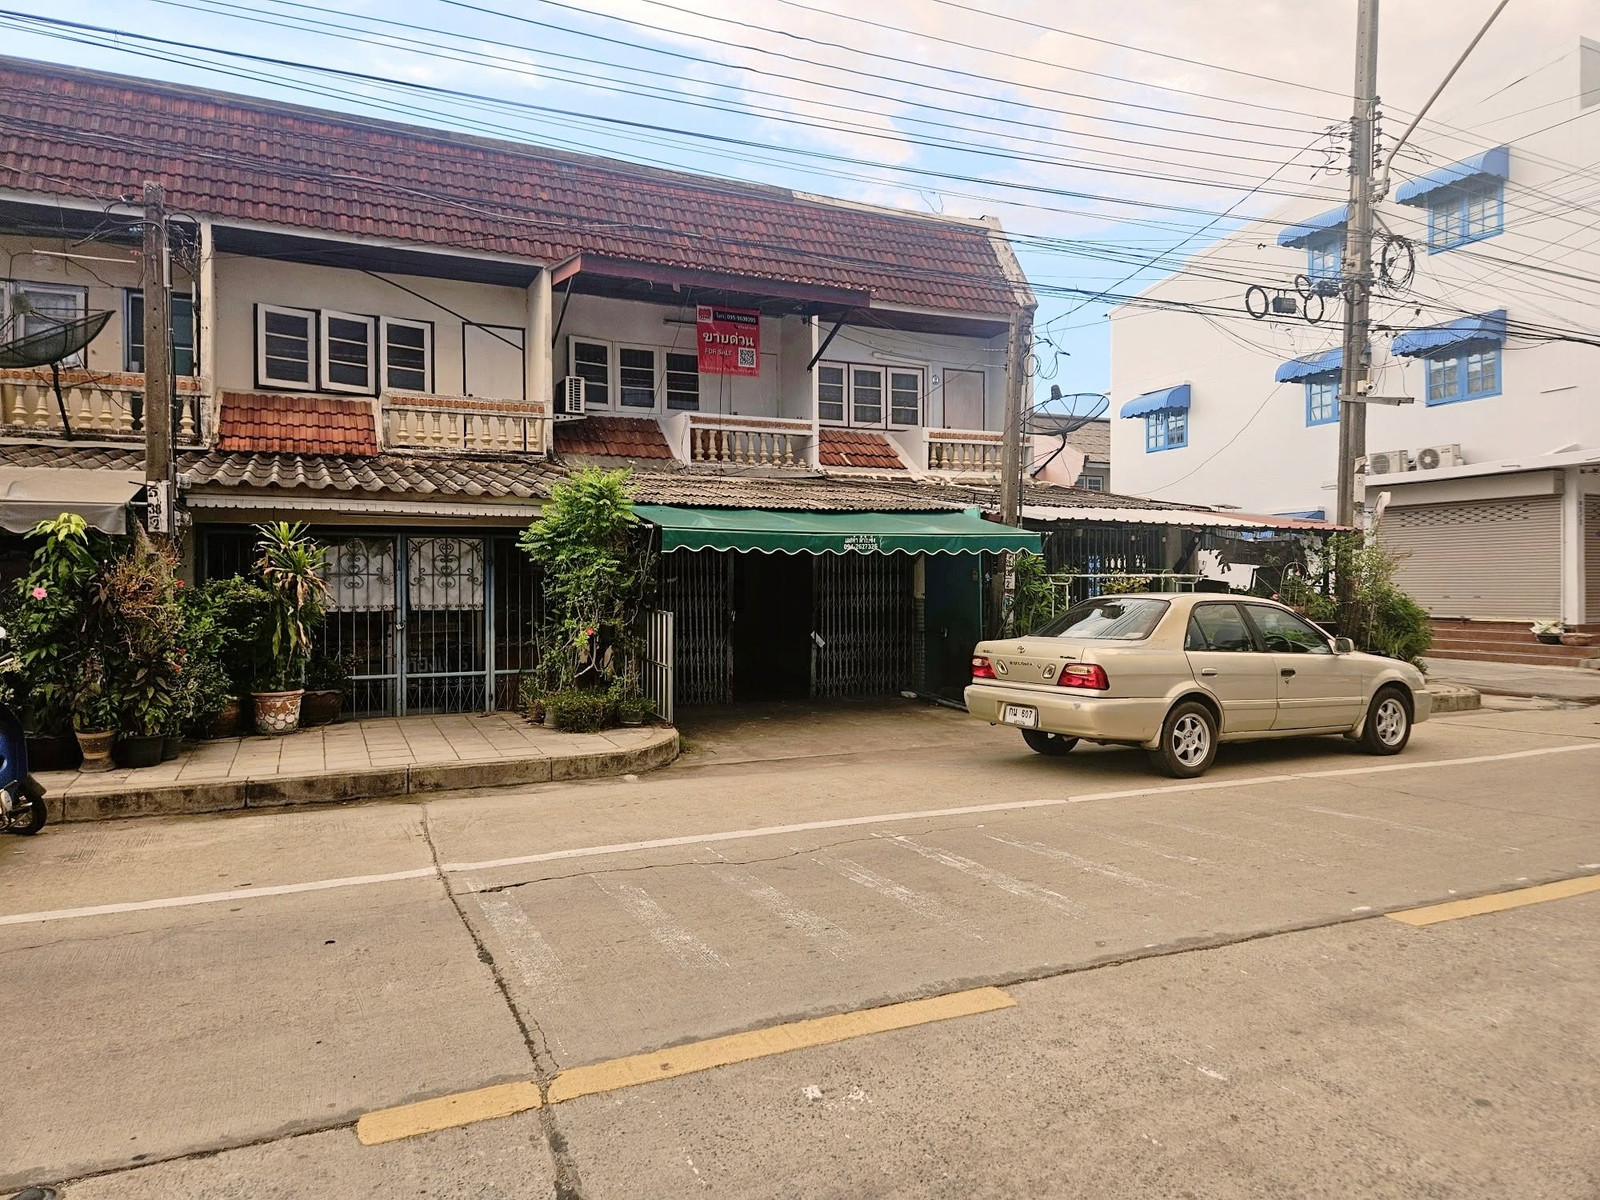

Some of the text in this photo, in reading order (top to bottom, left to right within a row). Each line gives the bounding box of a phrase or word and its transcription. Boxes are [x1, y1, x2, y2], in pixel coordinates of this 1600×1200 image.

[702, 332, 755, 346] ขายด่วน
[147, 503, 161, 514] 38
[151, 518, 160, 530] 2
[1021, 709, 1033, 719] 607
